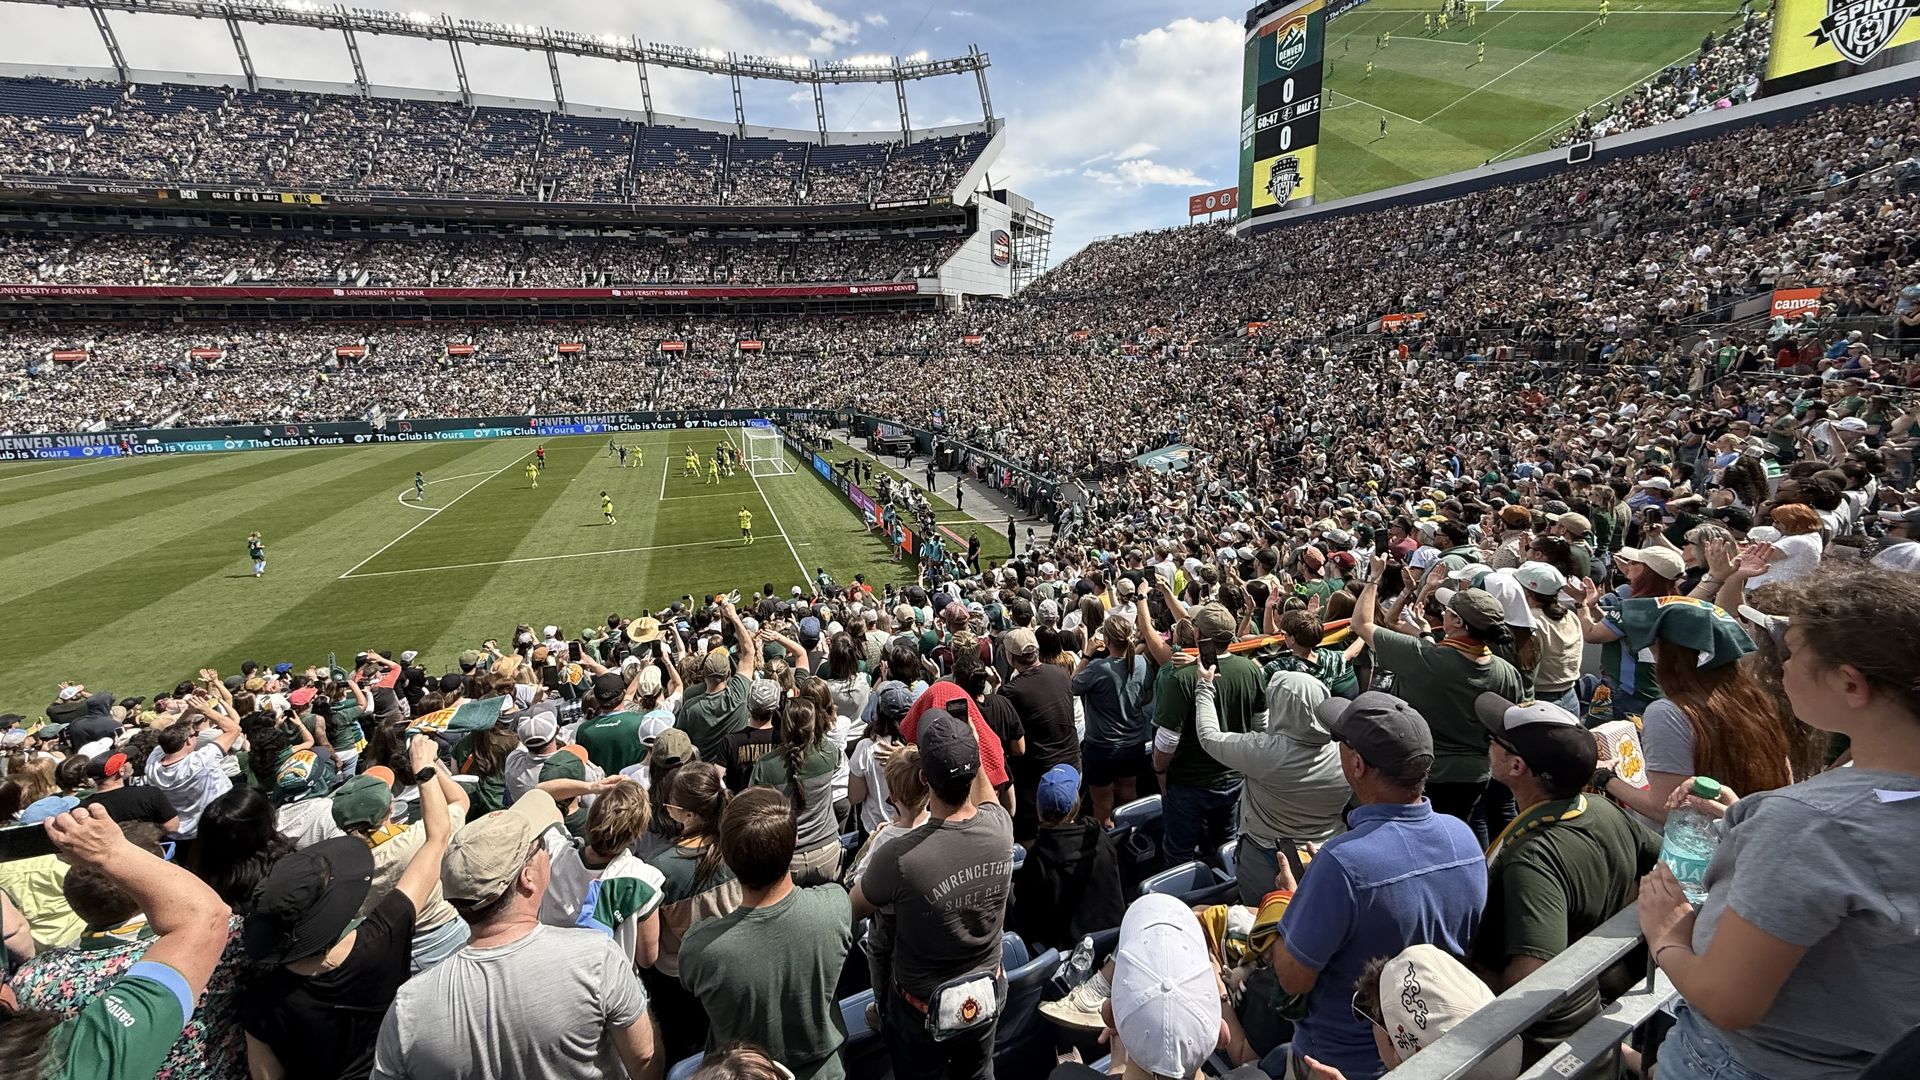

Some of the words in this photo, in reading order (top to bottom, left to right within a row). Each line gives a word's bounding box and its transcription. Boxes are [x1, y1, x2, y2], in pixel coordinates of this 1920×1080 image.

[1283, 78, 1294, 103] 0
[1257, 112, 1279, 129] 60:47
[1297, 101, 1312, 115] HALF
[1313, 97, 1319, 110] 2
[1280, 126, 1291, 150] 0
[1272, 173, 1295, 186] SPIRIT
[180, 189, 198, 199] DEN
[234, 192, 241, 201] 0
[252, 193, 259, 202] 0
[293, 194, 311, 204] WAS
[893, 284, 915, 292] DENVER
[602, 423, 619, 432] The
[620, 422, 640, 431] Club
[642, 421, 649, 430] is
[650, 420, 677, 430] Yours
[701, 419, 719, 428] The
[720, 419, 736, 427] Club
[738, 419, 745, 427] is
[376, 433, 397, 442] The
[398, 432, 422, 442] Club
[424, 432, 433, 440] is
[434, 431, 464, 440] Yours
[494, 428, 512, 437] The
[514, 427, 537, 436] Club
[538, 426, 546, 434] is
[547, 425, 575, 434] Yours
[135, 443, 163, 454] Club
[165, 444, 176, 452] is
[178, 442, 213, 452] Yours
[248, 439, 270, 448] The
[271, 437, 297, 447] Club
[300, 437, 310, 446] is
[311, 436, 344, 446] Yours
[17, 450, 29, 458] is
[31, 449, 70, 458] Yours
[923, 861, 1011, 905] LAWRENCETOW
[945, 890, 981, 912] SURF
